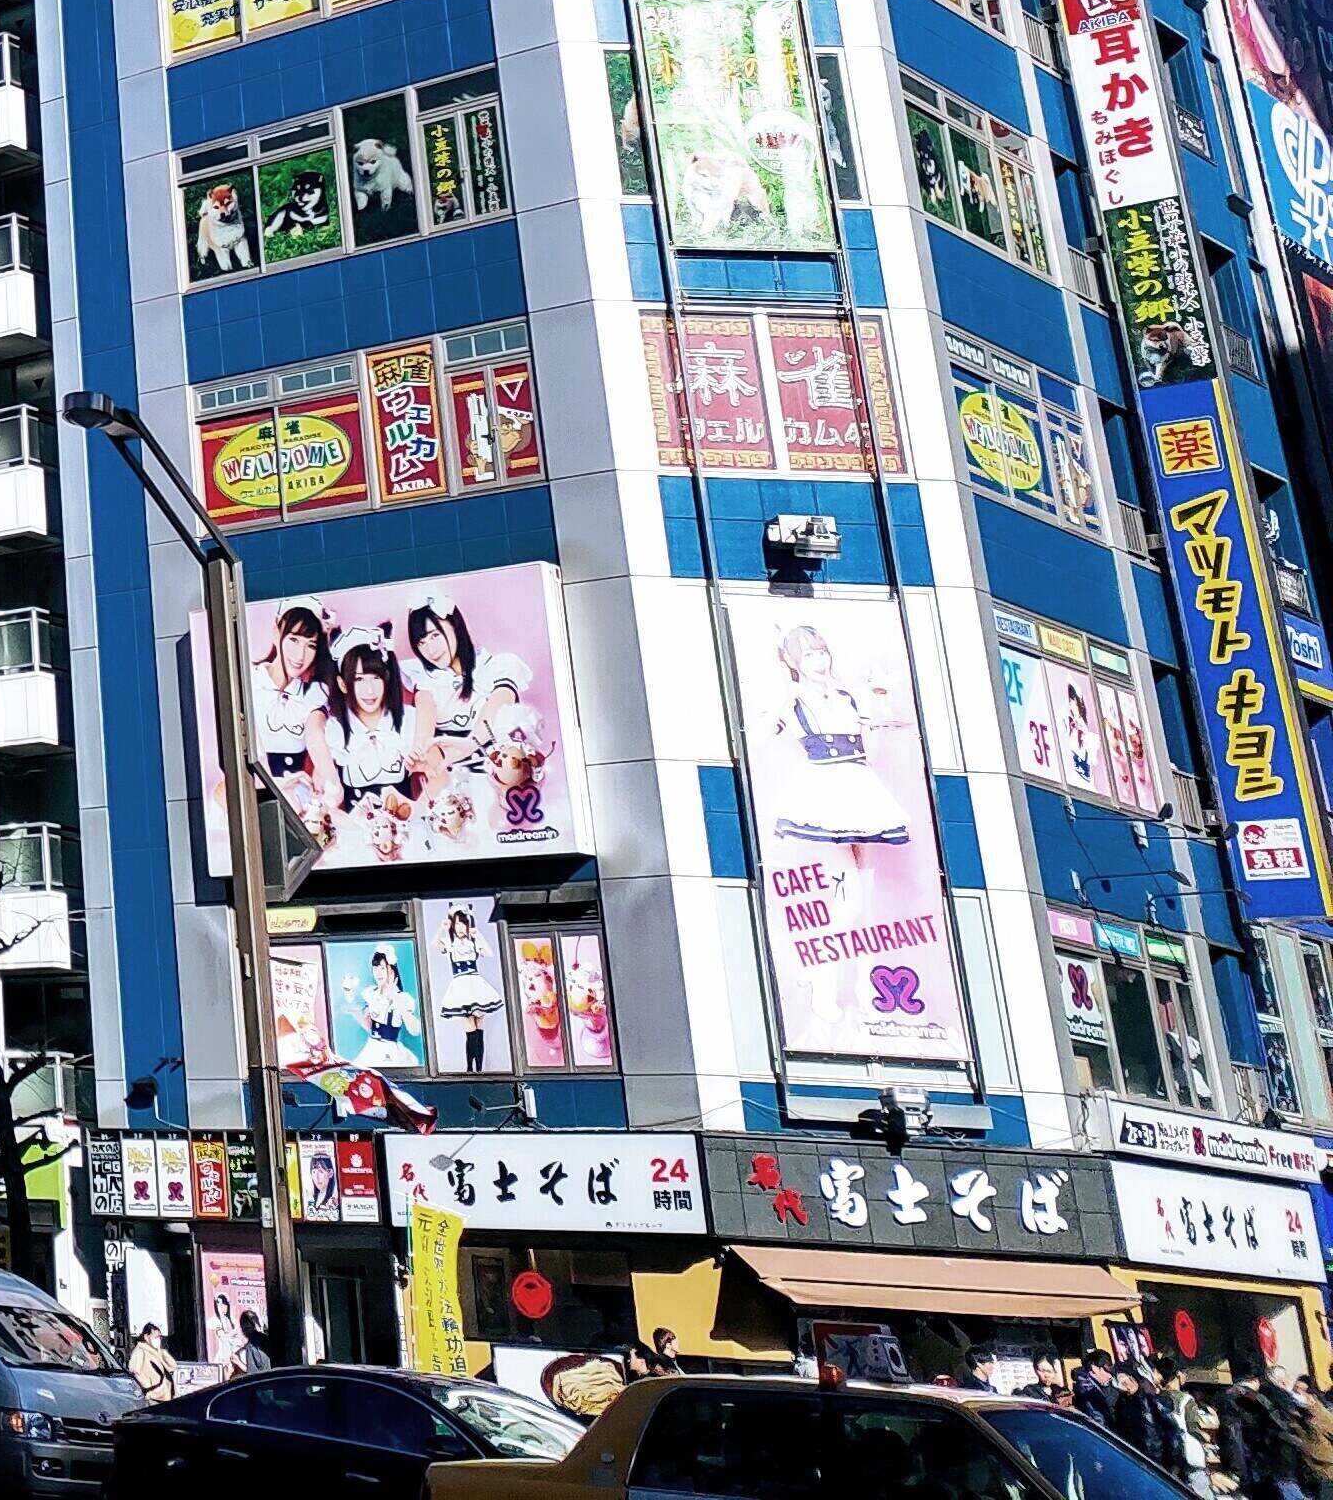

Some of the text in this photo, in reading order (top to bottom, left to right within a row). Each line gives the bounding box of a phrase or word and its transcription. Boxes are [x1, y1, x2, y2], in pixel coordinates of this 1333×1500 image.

[1080, 11, 1129, 33] AKIBA
[1090, 26, 1154, 158] 耳かき
[1091, 111, 1124, 205] もみほぐし
[1116, 209, 1175, 324] 小豆柴の郷
[372, 355, 433, 389] 麻雀
[683, 343, 864, 408] 麻雀
[256, 422, 302, 442] 麻雀
[381, 391, 440, 480] ウェルカム
[1162, 425, 1216, 471] 薬
[221, 439, 345, 483] WELCOME
[287, 475, 326, 490] AKIBA
[391, 478, 436, 493] AKIBA
[996, 615, 1033, 638] RESTAURANT
[1172, 492, 1283, 799] マツモトキヨシ
[1002, 658, 1023, 705] 2F
[1029, 721, 1050, 767] 3F
[496, 825, 560, 844] maidreamin
[1252, 849, 1299, 869] 免税
[772, 862, 827, 898] CAFE
[784, 905, 831, 933] AND
[795, 915, 939, 968] RESTAURANT
[650, 1158, 689, 1183] 24
[1268, 1145, 1293, 1169] Free
[447, 1157, 620, 1207] 富士そば
[820, 1159, 1070, 1235] 富士そば
[653, 1190, 692, 1212] 時間
[1286, 1209, 1303, 1234] 24
